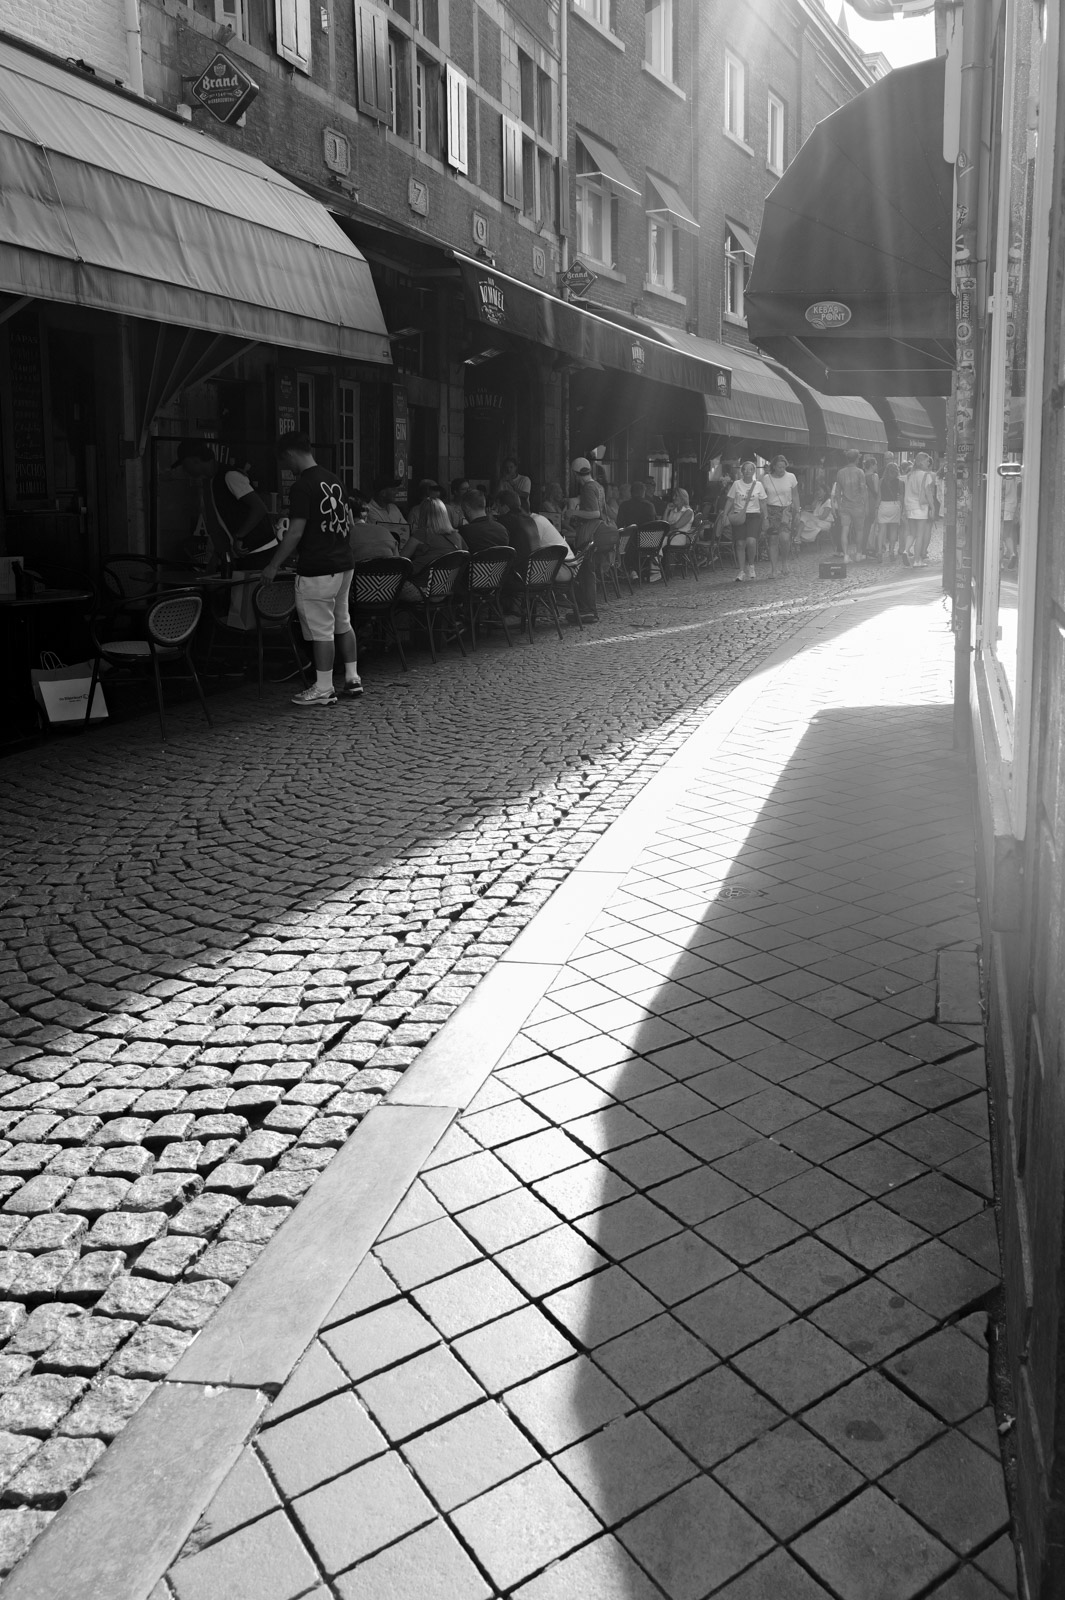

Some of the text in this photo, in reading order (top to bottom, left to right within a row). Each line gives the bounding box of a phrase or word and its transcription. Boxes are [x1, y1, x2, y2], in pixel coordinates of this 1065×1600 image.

[202, 74, 238, 90] Brand
[413, 182, 424, 206] 7
[566, 271, 588, 280] Brand
[813, 305, 839, 314] KEBAB
[821, 313, 846, 321] POINT
[279, 418, 295, 435] BEER
[395, 423, 407, 441] GIN
